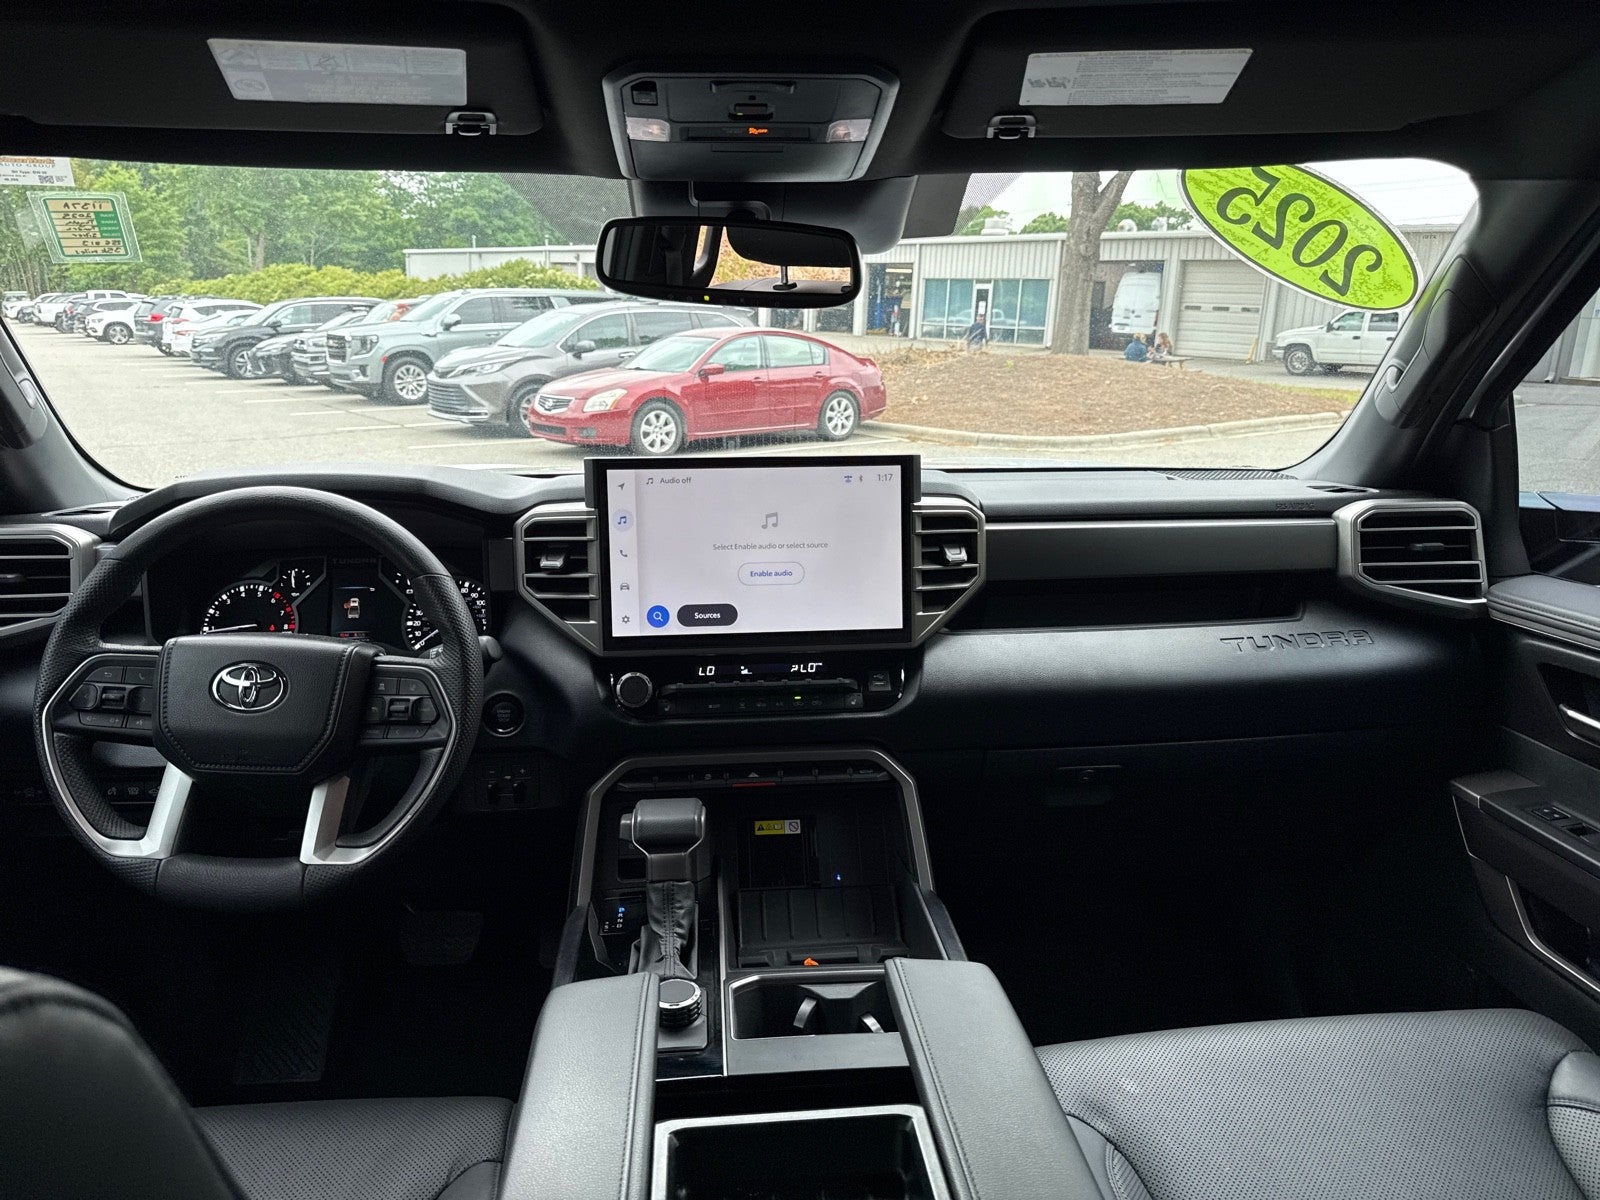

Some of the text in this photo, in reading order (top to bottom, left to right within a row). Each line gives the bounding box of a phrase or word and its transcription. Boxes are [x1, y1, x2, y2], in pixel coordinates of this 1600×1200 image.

[660, 476, 692, 484] Audio off
[877, 473, 893, 482] 1:17
[758, 542, 777, 550] audio
[1219, 629, 1375, 653] TUNDRA
[698, 665, 716, 676] LO
